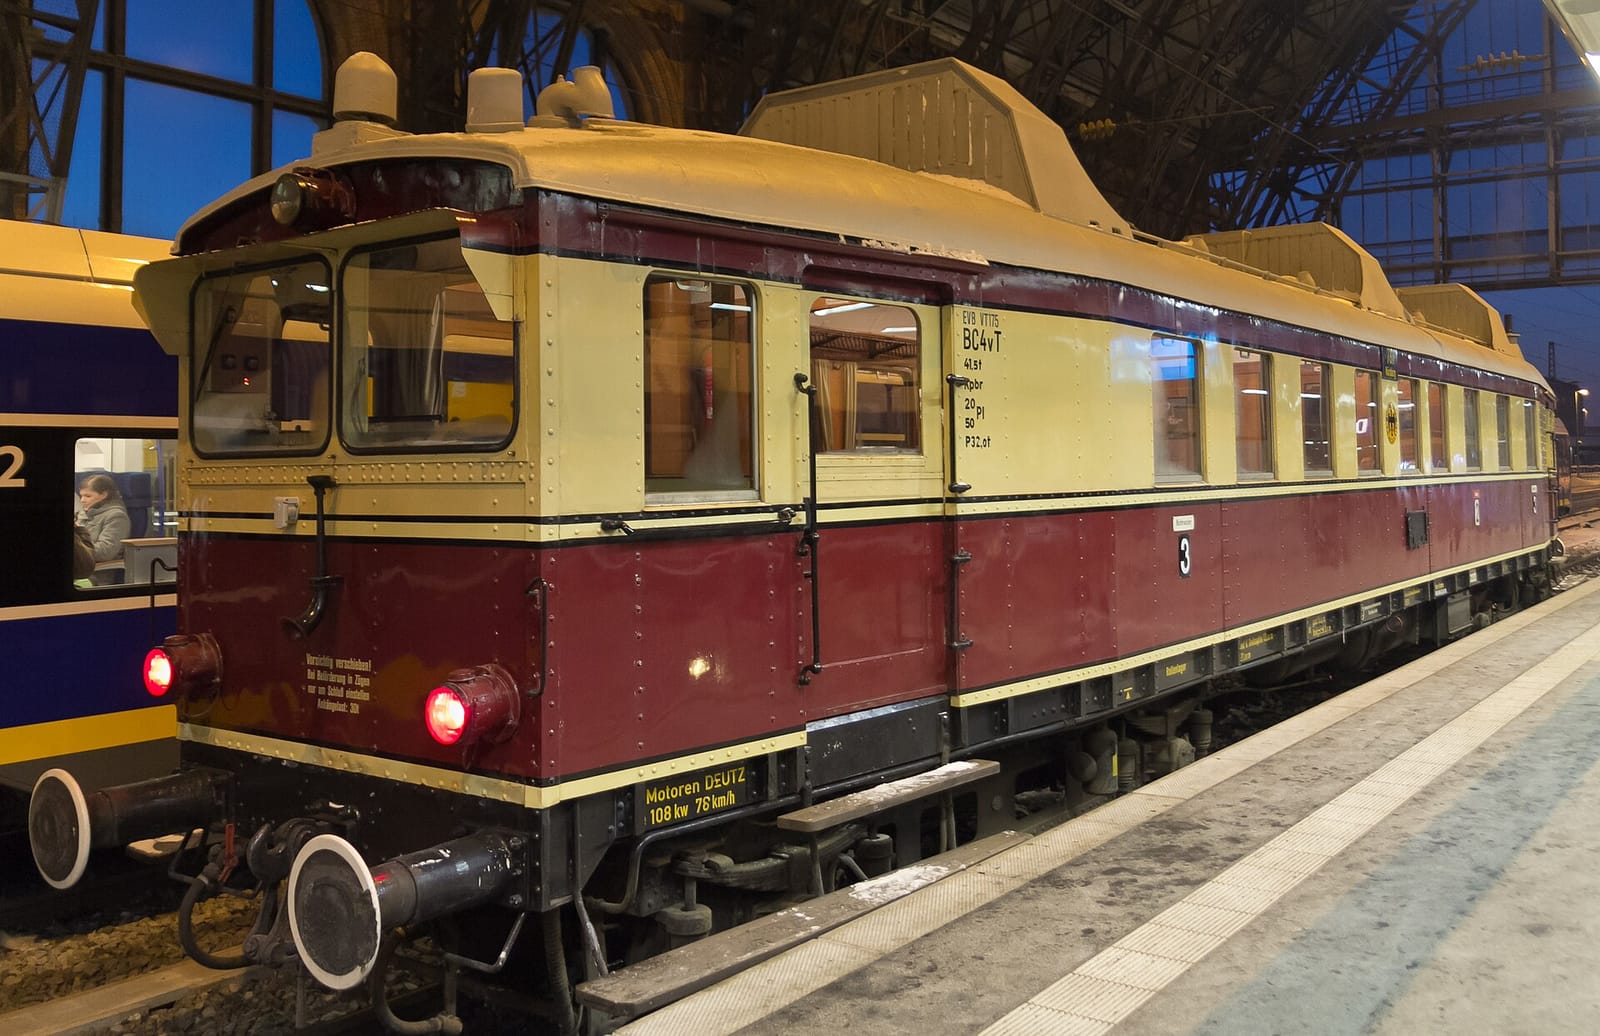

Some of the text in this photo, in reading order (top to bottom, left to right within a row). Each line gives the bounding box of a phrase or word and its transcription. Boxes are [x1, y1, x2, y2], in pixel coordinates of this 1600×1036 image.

[963, 311, 976, 325] EVB
[963, 327, 1002, 352] BC4vT
[965, 398, 976, 410] 20
[965, 417, 974, 429] 50
[0, 446, 25, 487] 2
[1180, 538, 1190, 574] 3
[646, 767, 746, 805] Motoren DEUTZ
[650, 805, 672, 825] 108
[712, 790, 735, 809] km/h
